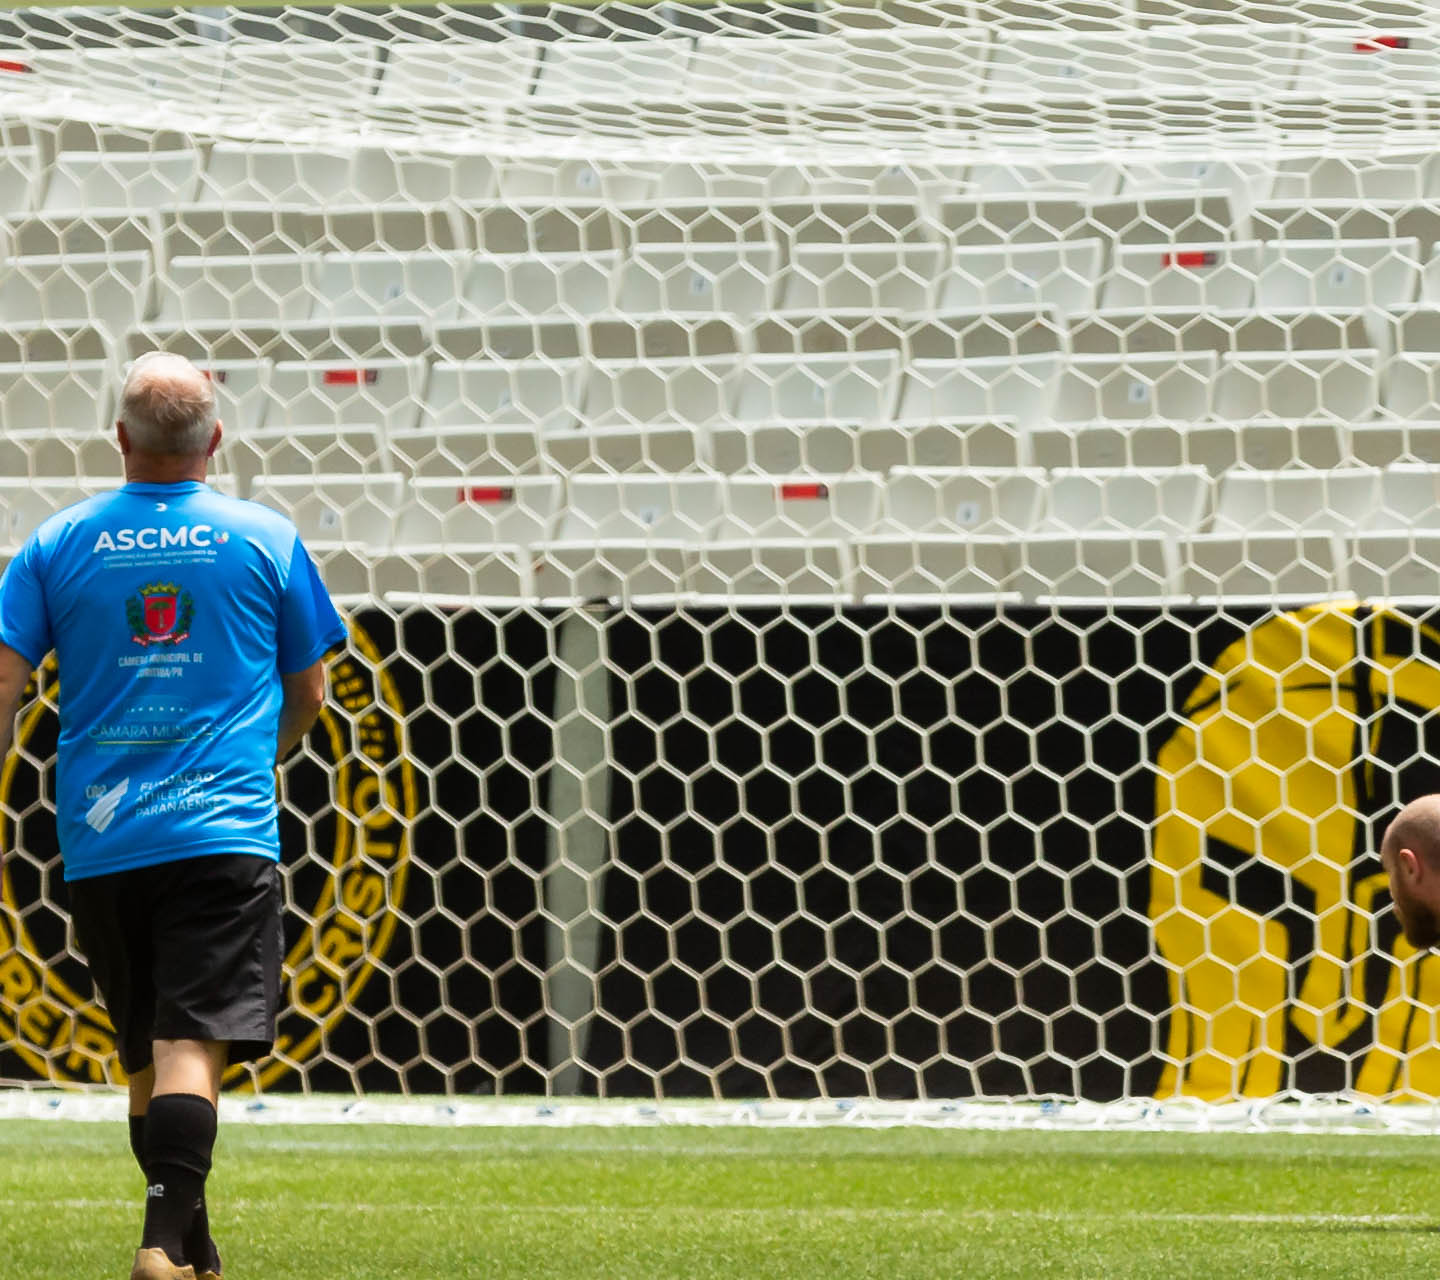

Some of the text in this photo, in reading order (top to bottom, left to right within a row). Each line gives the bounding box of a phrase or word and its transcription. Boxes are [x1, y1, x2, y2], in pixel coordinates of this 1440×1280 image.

[93, 524, 213, 553] ASCMC
[87, 721, 150, 739] CÂMARA
[135, 798, 221, 818] PARANAENSE
[287, 776, 397, 1015] CRISTO
